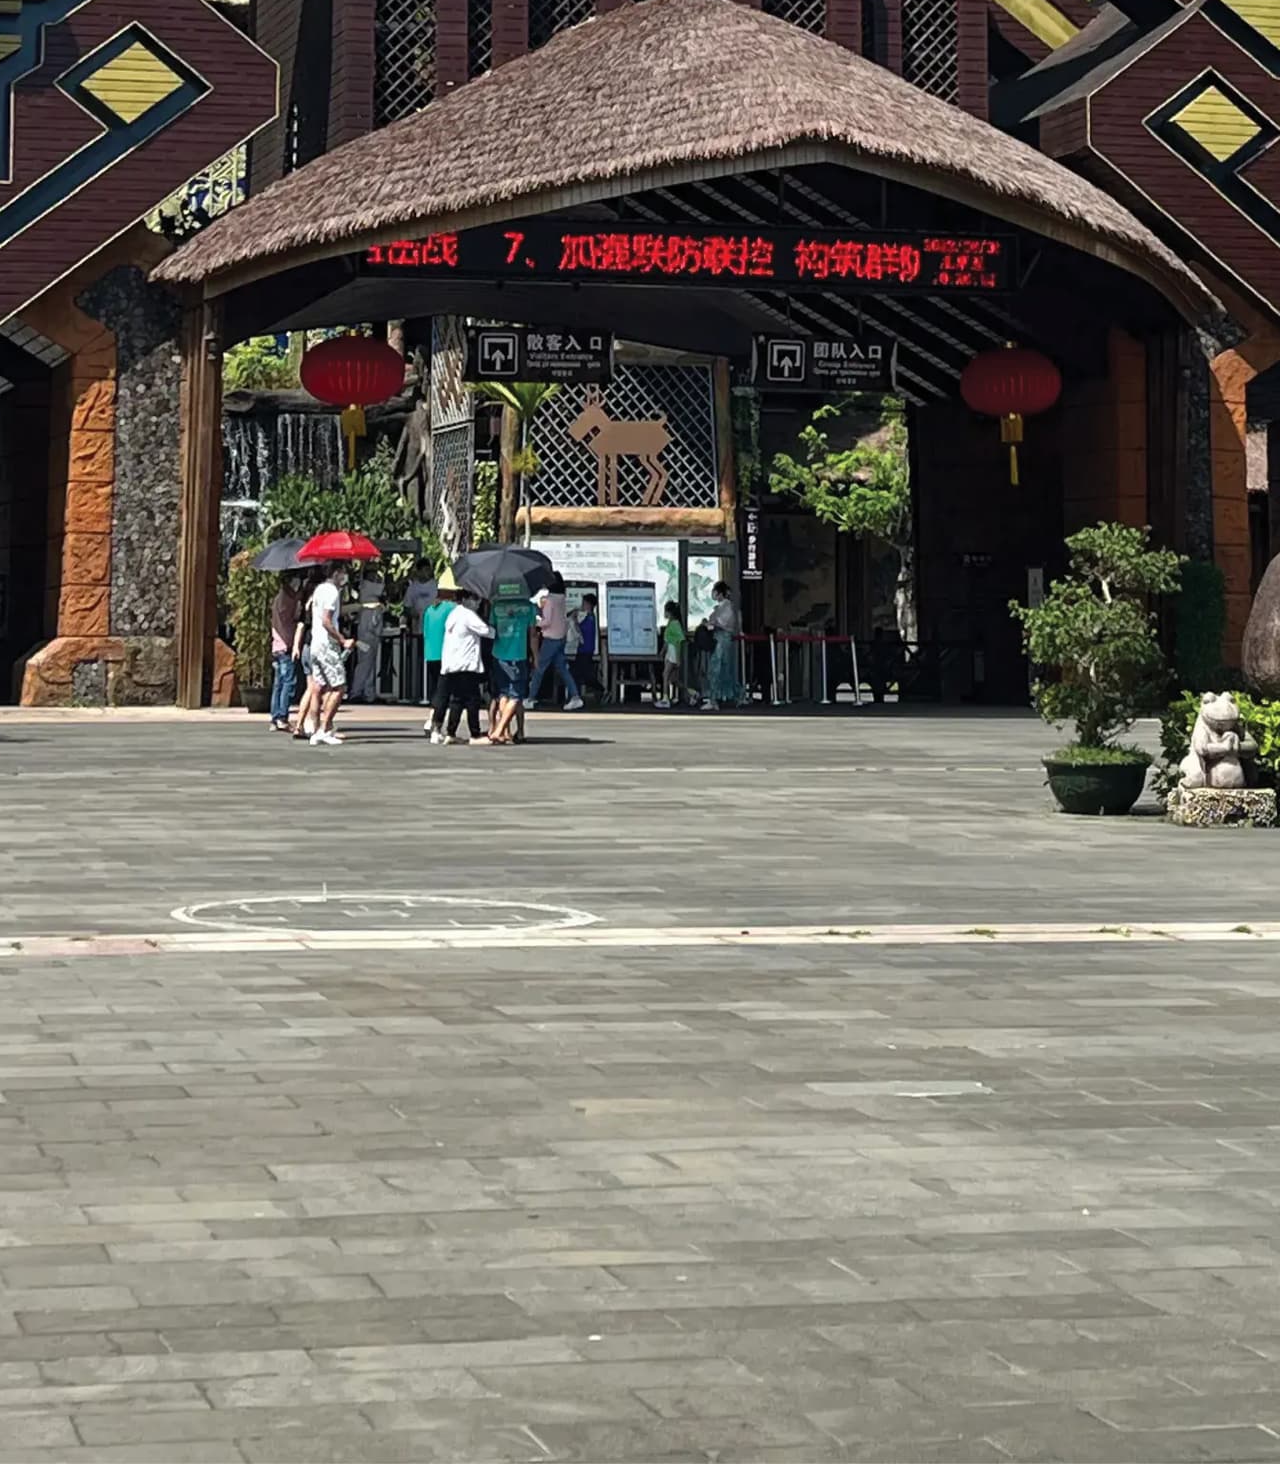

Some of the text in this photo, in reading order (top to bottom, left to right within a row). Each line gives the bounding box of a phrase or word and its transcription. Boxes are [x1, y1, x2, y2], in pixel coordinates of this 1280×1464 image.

[527, 334, 602, 351] 散客入口
[814, 342, 881, 359] 团队入口
